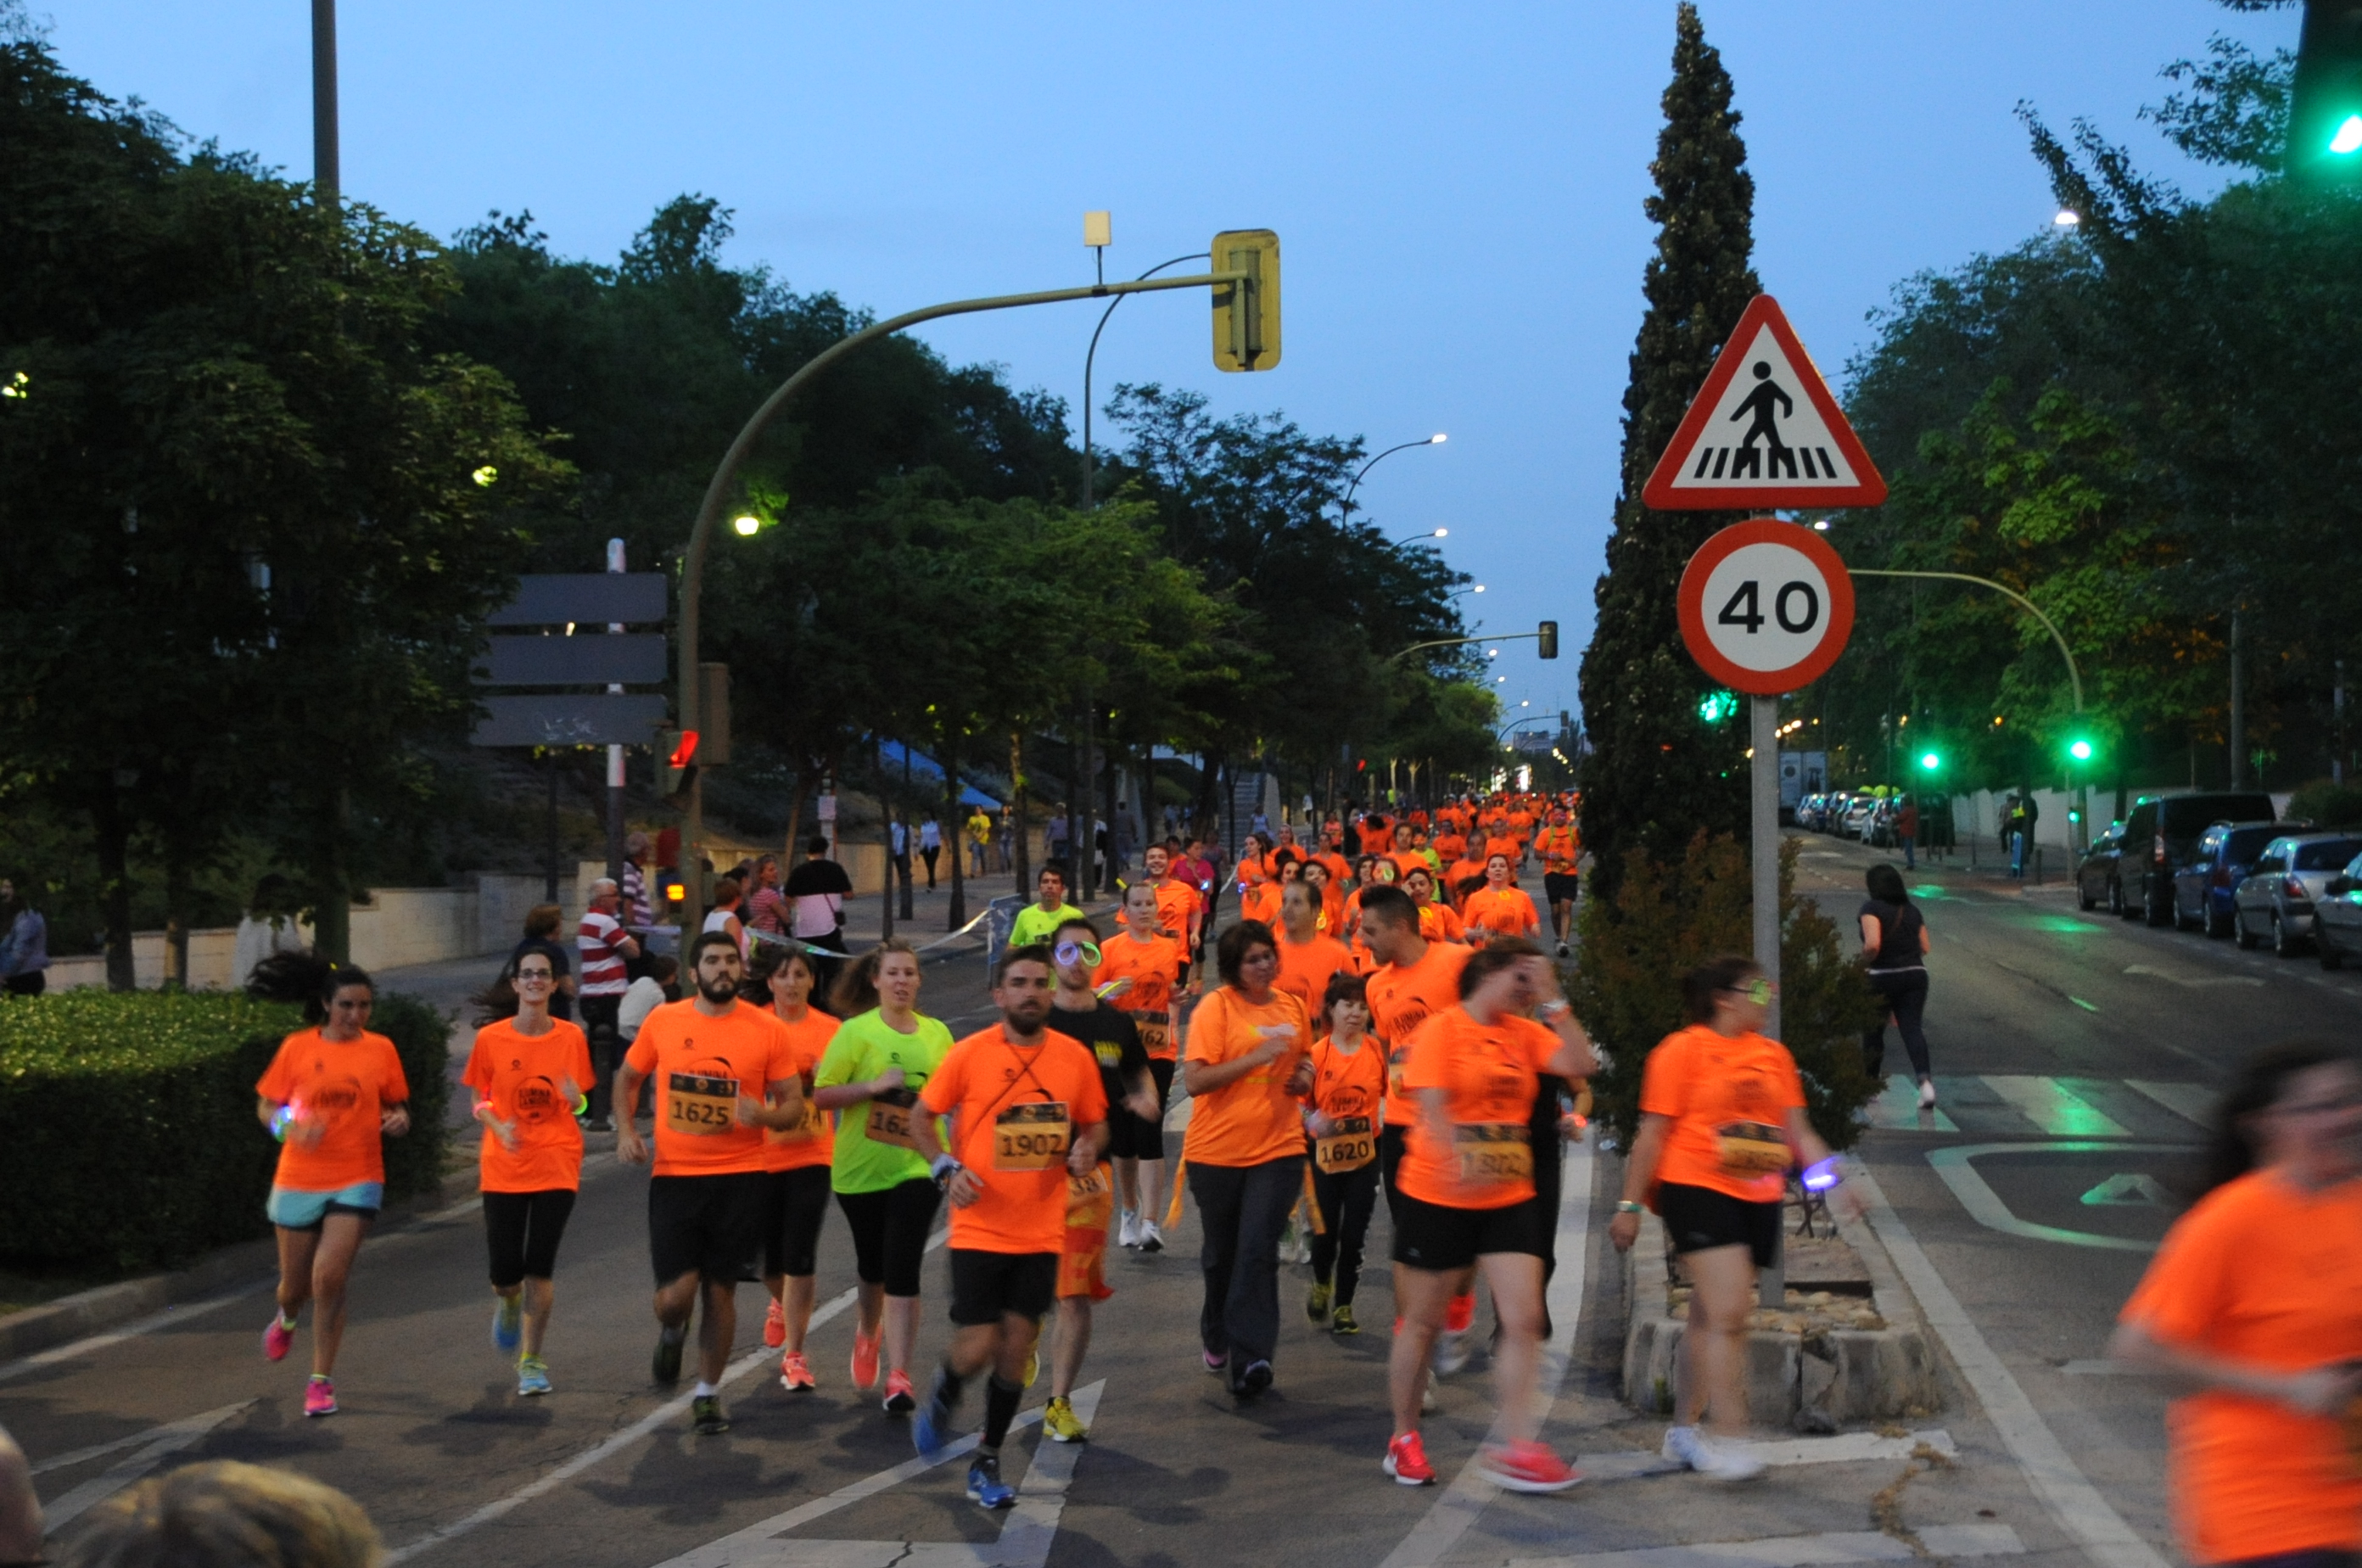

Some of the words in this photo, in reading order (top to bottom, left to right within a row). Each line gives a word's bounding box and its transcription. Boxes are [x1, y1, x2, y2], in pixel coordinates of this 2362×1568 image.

[1718, 580, 1819, 634] 40
[673, 1101, 730, 1126] 1625
[1001, 1134, 1064, 1157] 1902
[1321, 1140, 1370, 1163] 1620
